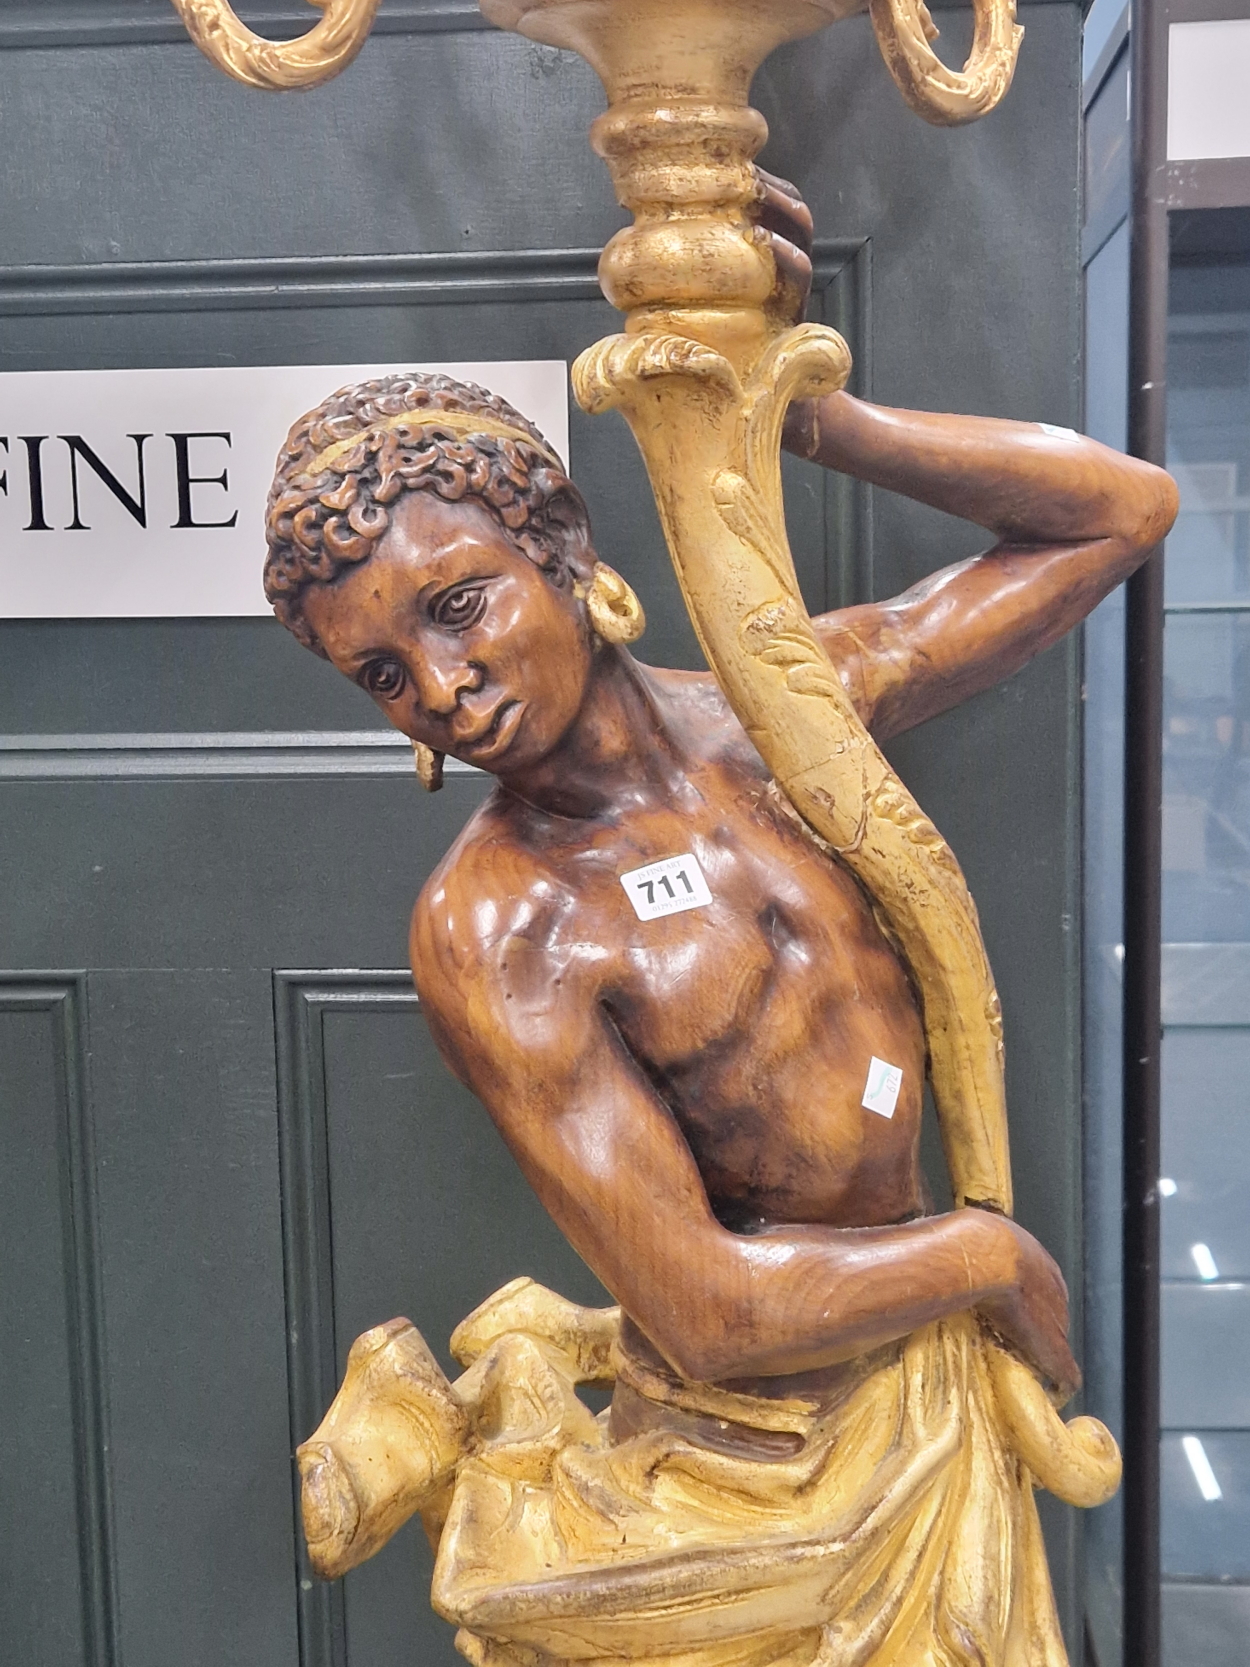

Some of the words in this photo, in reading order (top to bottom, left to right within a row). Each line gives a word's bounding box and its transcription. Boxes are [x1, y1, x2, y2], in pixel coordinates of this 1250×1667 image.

[0, 432, 239, 530] INE
[637, 872, 646, 881] JS
[646, 866, 665, 877] FINE
[666, 860, 681, 869] ART
[637, 870, 694, 904] 711
